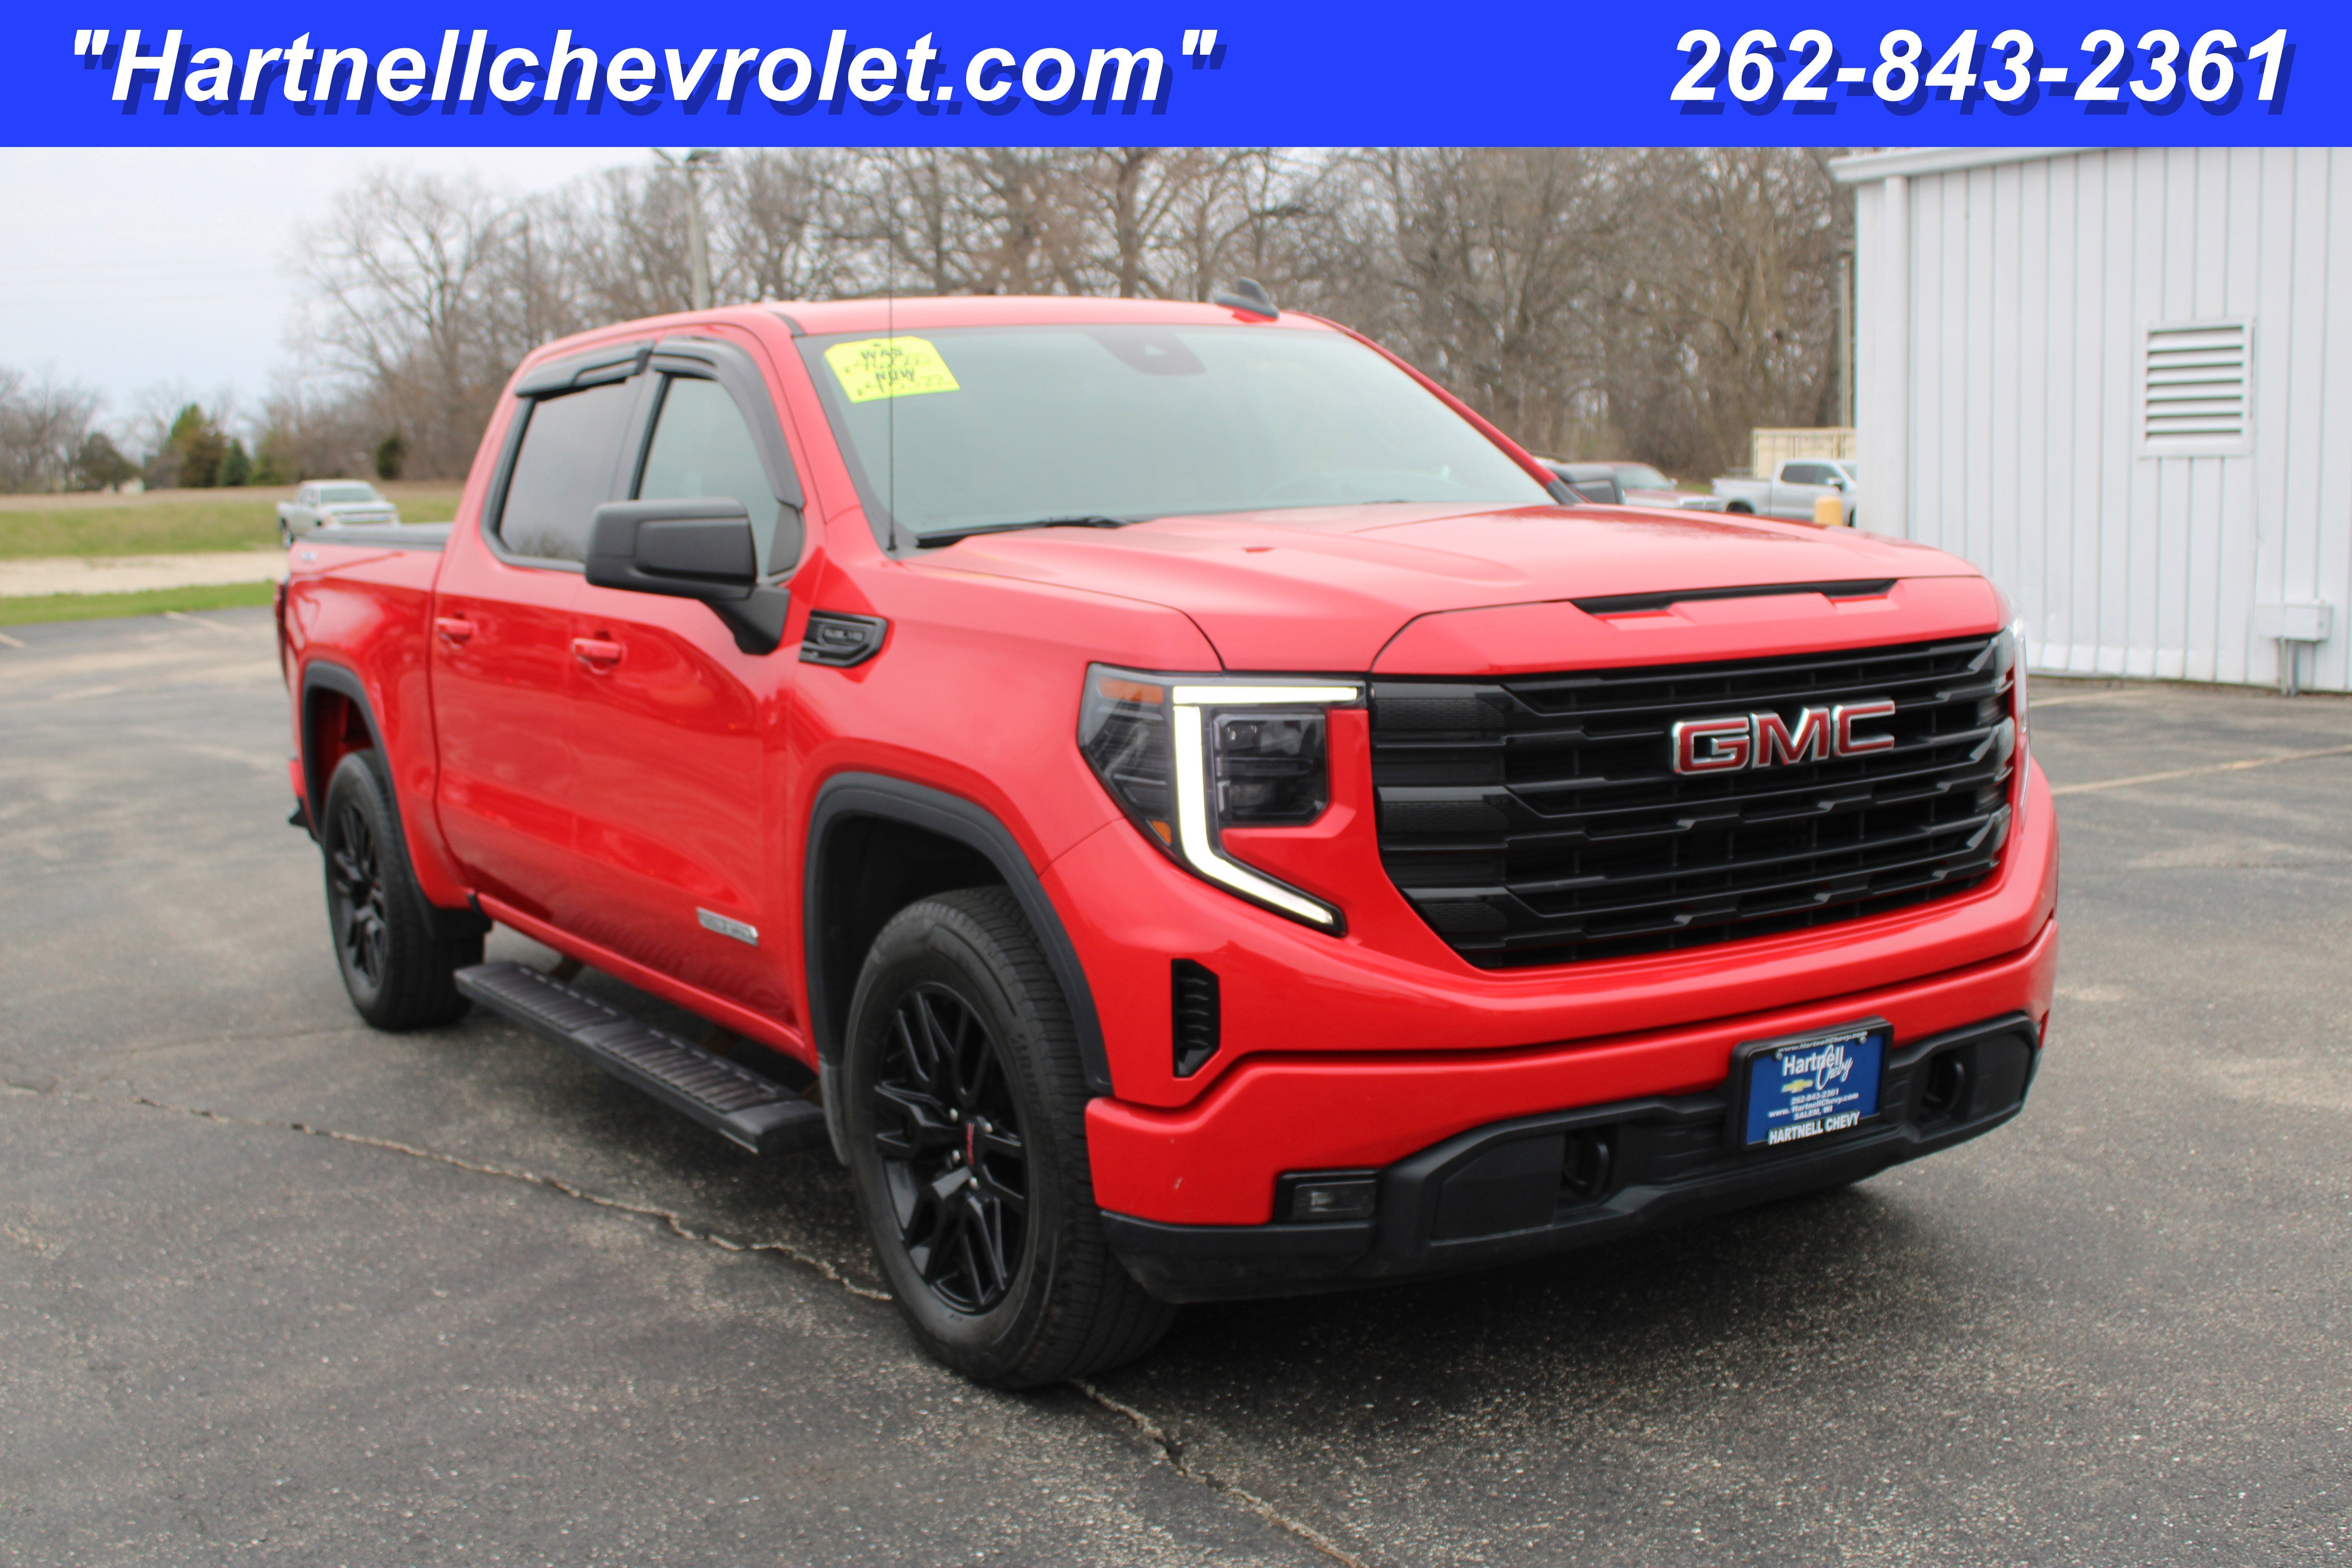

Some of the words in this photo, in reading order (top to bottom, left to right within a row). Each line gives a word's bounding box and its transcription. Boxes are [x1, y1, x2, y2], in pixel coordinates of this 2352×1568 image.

[1672, 699, 1895, 775] GMC
[1778, 1031, 1867, 1052] www.HartnellChevy.com
[1782, 1045, 1844, 1076] Hartnell
[1815, 1044, 1853, 1090] Chevy
[1768, 1108, 1790, 1118] www.
[1792, 1092, 1859, 1113] HartnellChevy.com
[1791, 1088, 1839, 1105] 262-843-2361
[1793, 1108, 1821, 1120] SALEM,
[1823, 1105, 1833, 1114] WI
[1768, 1120, 1824, 1145] HARTNELL
[1824, 1111, 1860, 1132] CHEVY
